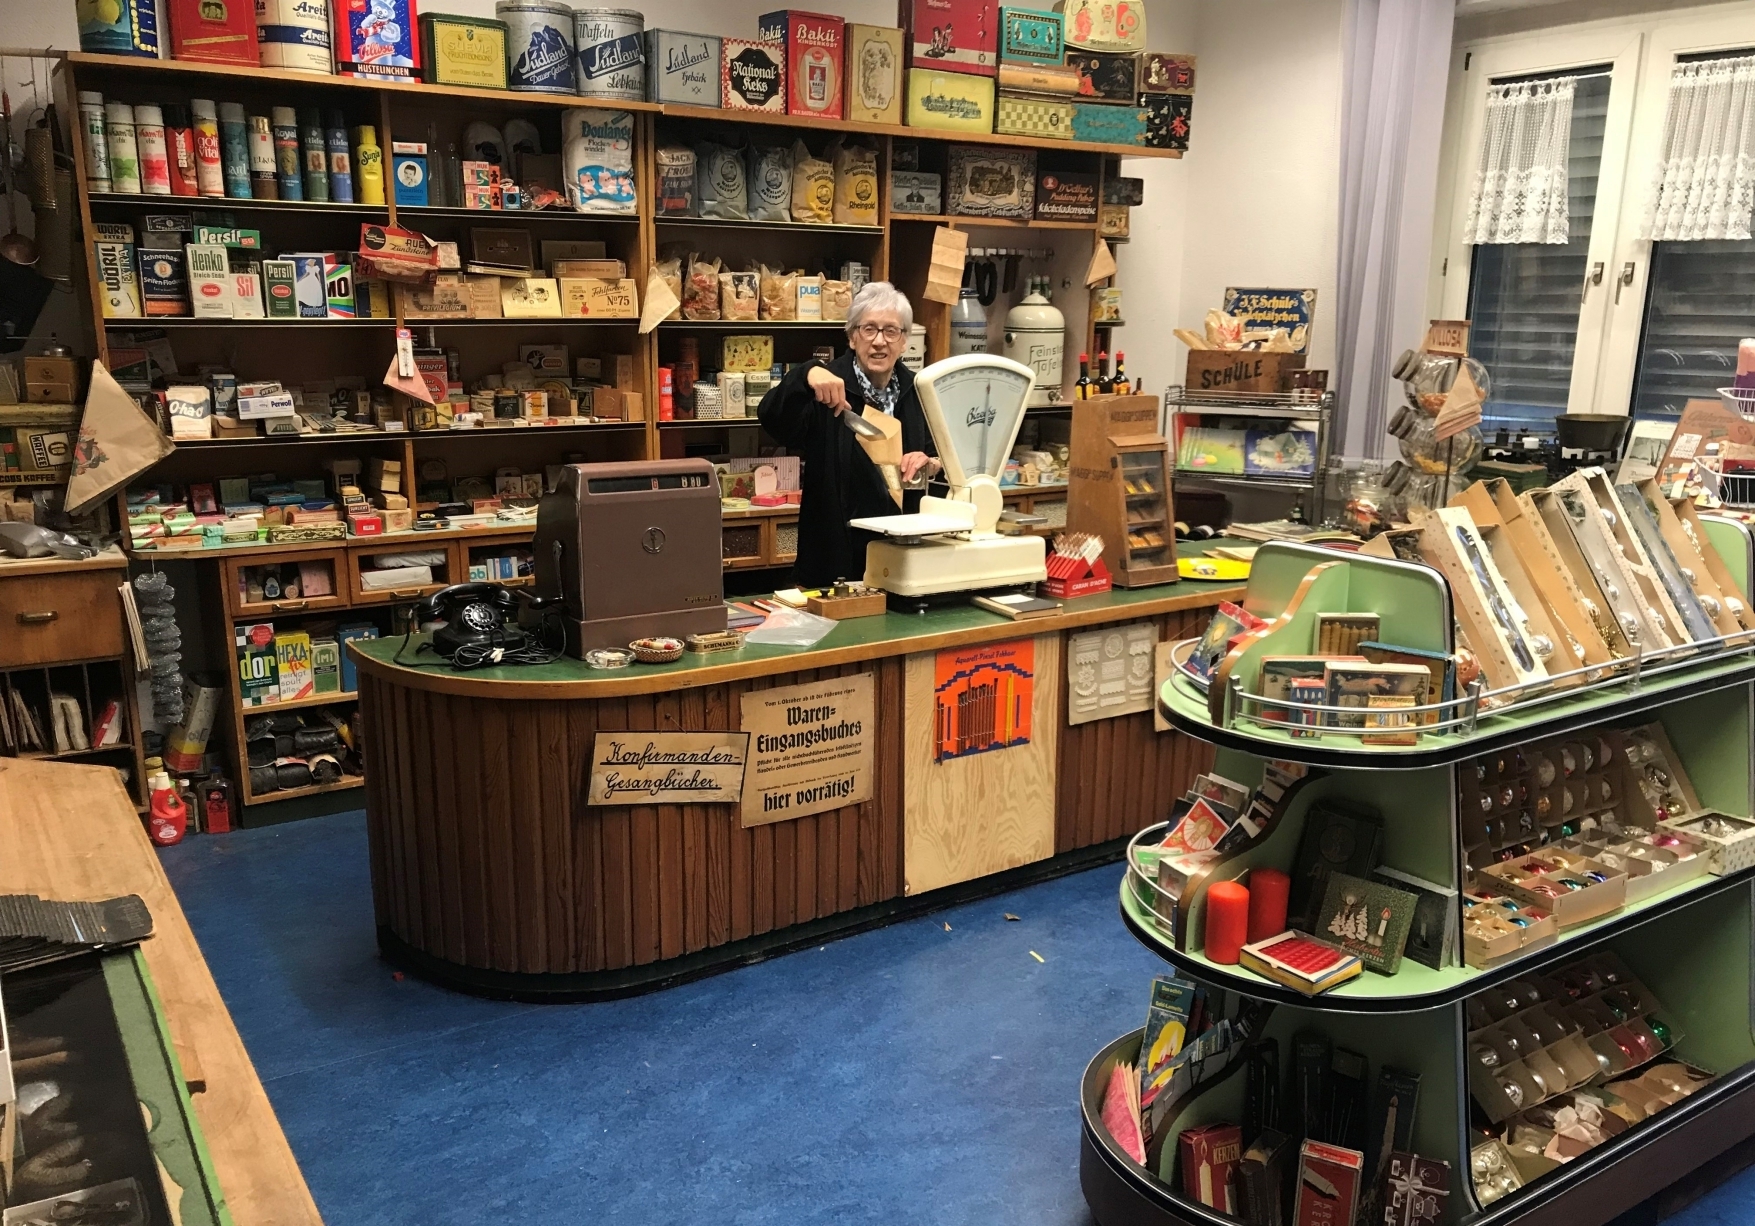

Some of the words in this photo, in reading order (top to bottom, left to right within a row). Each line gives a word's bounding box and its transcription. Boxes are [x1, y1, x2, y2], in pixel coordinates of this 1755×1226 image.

[577, 22, 614, 42] Waffeln
[797, 39, 838, 48] KINDERKOST
[519, 36, 568, 74] Südland
[589, 35, 643, 72] Südland
[665, 42, 713, 74] Südland
[357, 63, 410, 76] HUSTELINCHEN
[742, 76, 768, 93] Keks
[275, 128, 297, 140] Royal
[175, 131, 188, 168] BRISK
[198, 146, 220, 159] vital
[668, 153, 692, 164] JACK
[849, 200, 876, 211] Rheingold
[199, 227, 241, 245] Persil
[191, 248, 225, 273] Henko
[267, 264, 293, 279] Persil
[236, 275, 255, 297] Sil
[799, 284, 821, 298] pura
[1201, 358, 1264, 390] SCHÜLE
[270, 399, 292, 408] Perwoll
[31, 435, 49, 468] KAFFEE
[23, 473, 57, 483] KAFFEE
[651, 478, 658, 490] G
[1071, 582, 1090, 591] CARAN
[276, 641, 310, 665] HEXA-
[316, 651, 334, 664] imi
[240, 650, 276, 681] dor
[288, 655, 307, 676] fix
[280, 677, 302, 687] spült
[281, 685, 301, 695] alles
[756, 719, 862, 754] Eingangsbuches
[605, 741, 741, 771] Konfirmanden-
[775, 762, 787, 771] oder
[603, 768, 720, 800] Gesangbücher.
[763, 790, 792, 813] hier
[796, 774, 856, 806] vorrätig!
[1212, 1138, 1241, 1166] KERZEN
